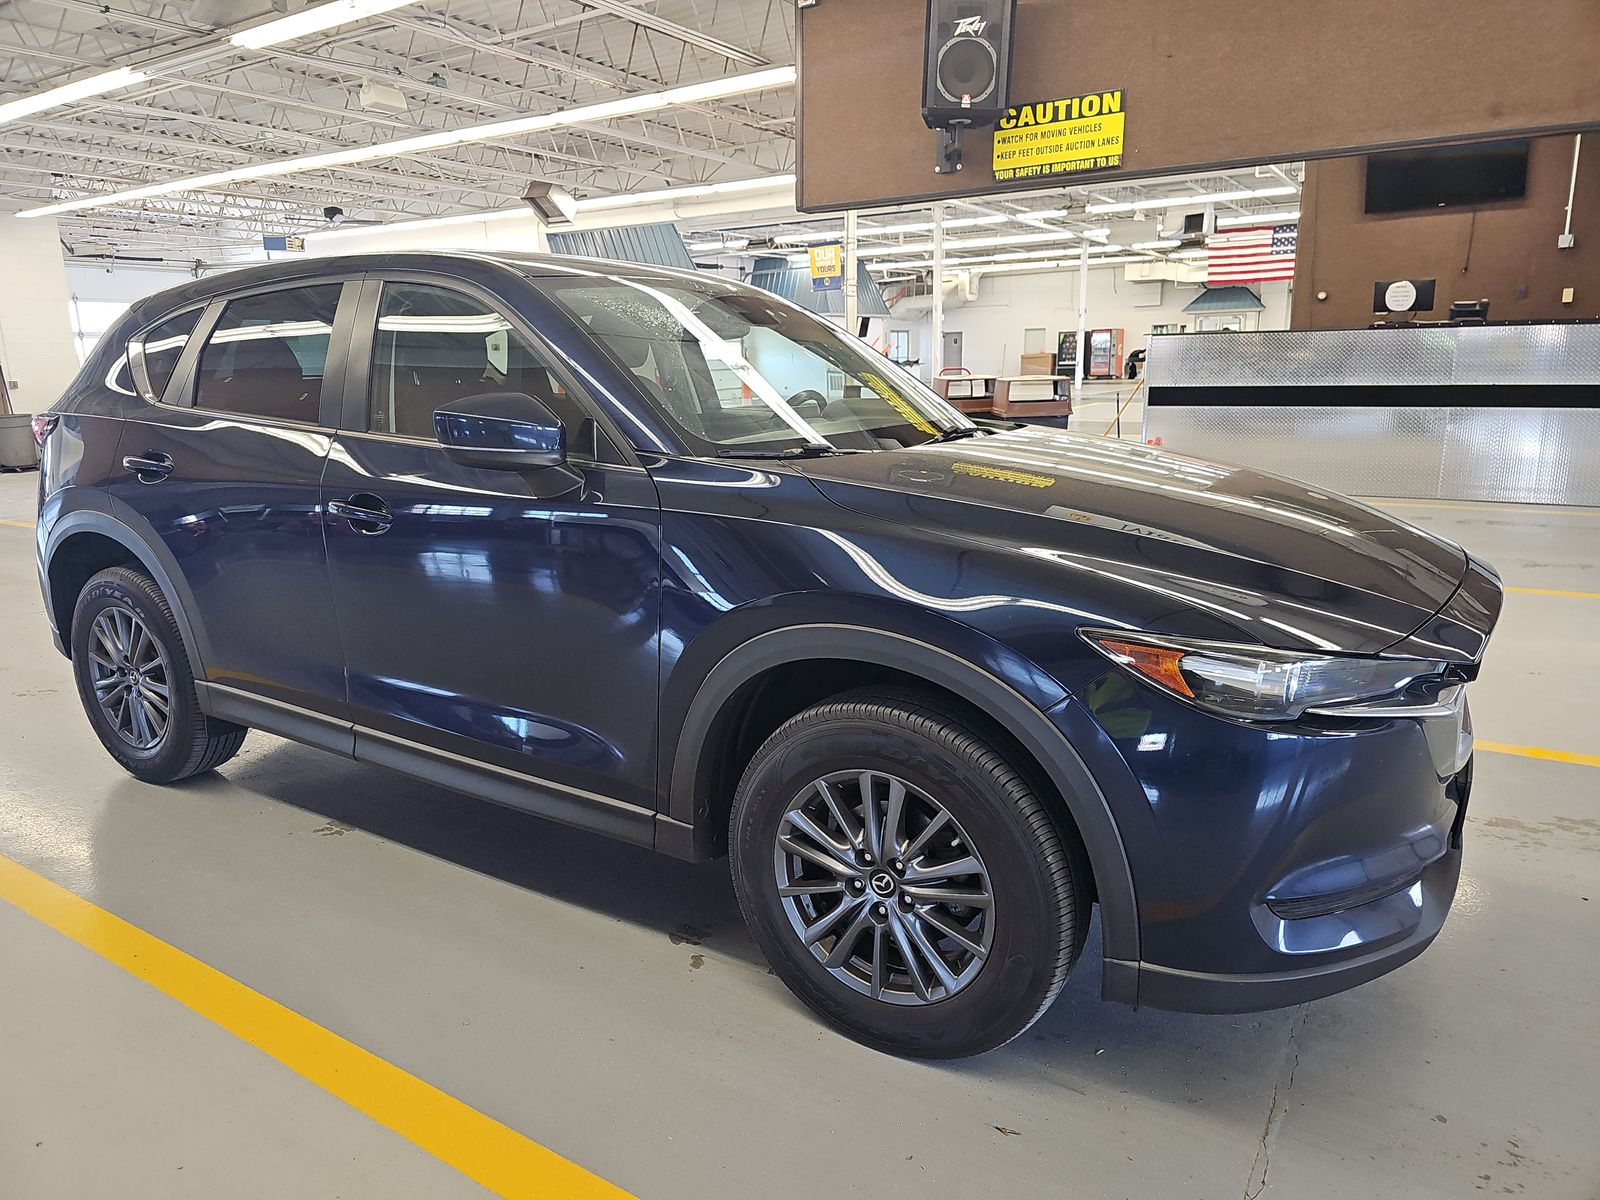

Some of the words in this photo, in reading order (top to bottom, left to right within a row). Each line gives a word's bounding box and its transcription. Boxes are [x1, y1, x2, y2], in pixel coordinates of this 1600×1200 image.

[1000, 91, 1121, 129] CAUTION
[1000, 134, 1024, 145] WATCH
[1025, 132, 1039, 142] FOR
[1040, 128, 1067, 139] MOVING
[1069, 122, 1102, 136] VEHICLES
[1000, 150, 1017, 160] KEEP
[1018, 147, 1034, 158] FEET
[1035, 144, 1064, 156] OUTSIDE
[1065, 139, 1096, 151] AUCTION
[1097, 135, 1120, 147] LANES
[994, 169, 1014, 180] YOUR
[1015, 165, 1042, 178] SAFETY
[1042, 164, 1051, 174] IS
[1051, 158, 1095, 173] IMPORTANT
[1096, 156, 1107, 169] TO
[1108, 155, 1119, 167] US
[816, 264, 836, 274] YOURS
